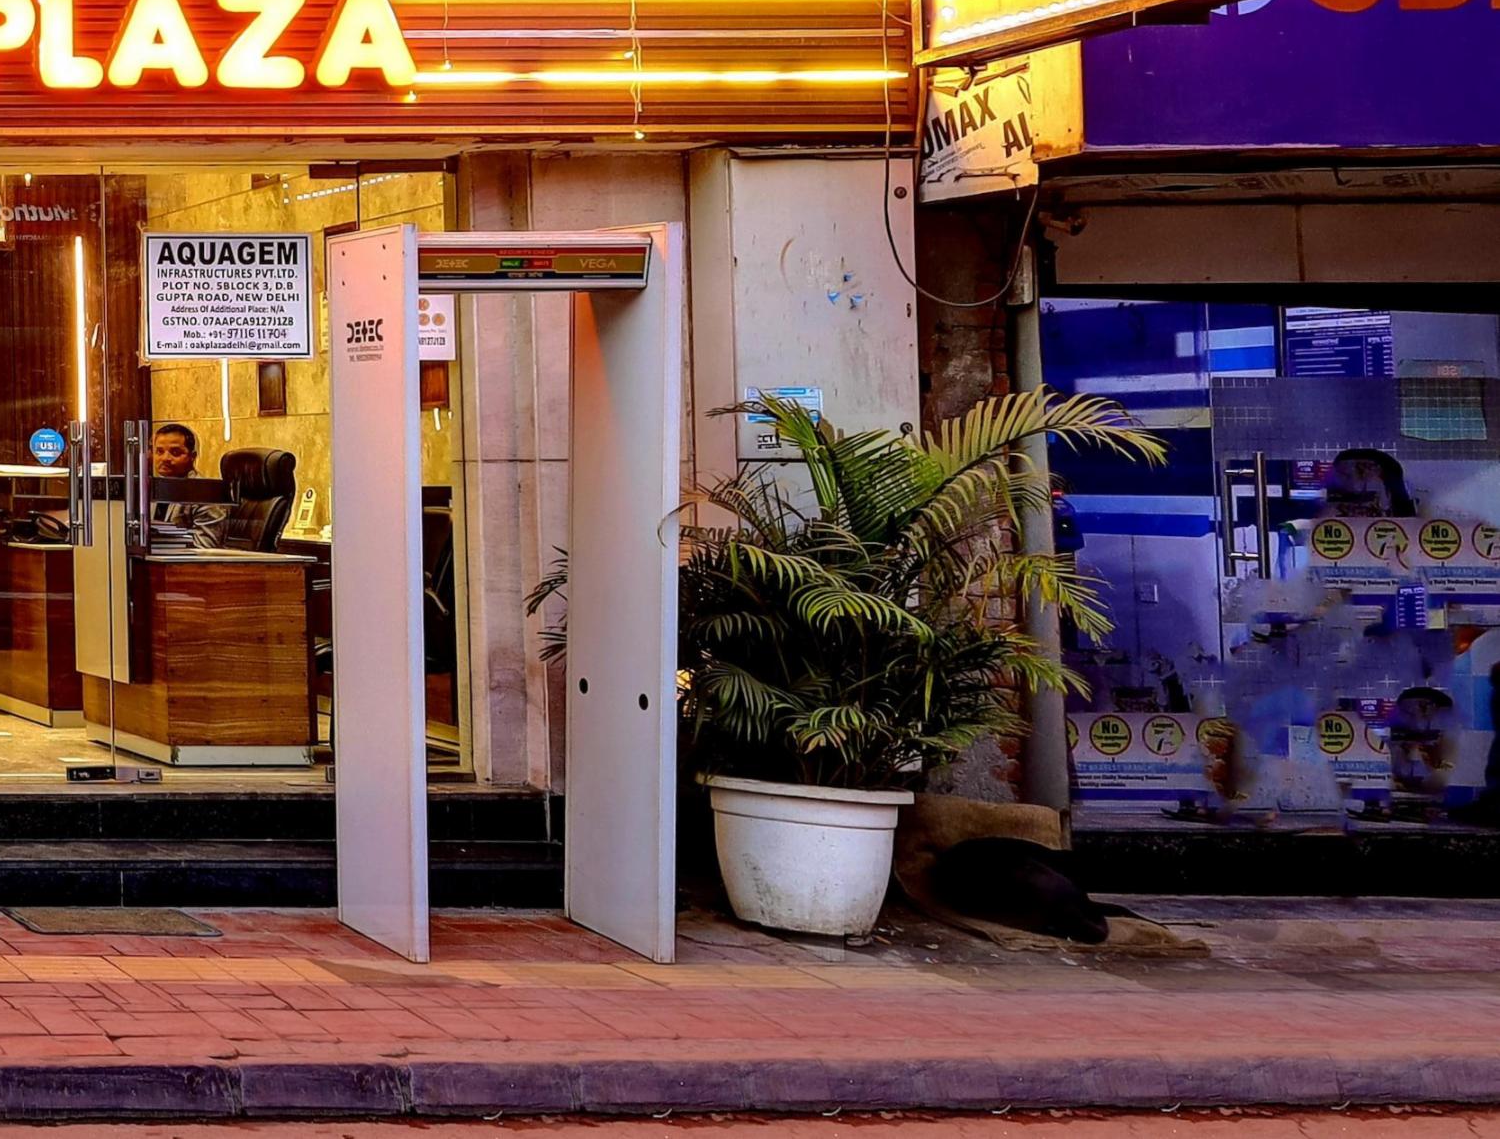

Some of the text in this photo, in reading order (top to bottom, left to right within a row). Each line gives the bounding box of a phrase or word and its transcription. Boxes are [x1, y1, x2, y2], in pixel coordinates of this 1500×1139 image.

[157, 241, 298, 267] AQUAGEM
[579, 258, 617, 269] VEGA
[157, 268, 298, 278] INFRASTRUCTURES PVT.LTD.
[162, 281, 294, 292] PLOT NO. 5BLOCK 3, D.B
[156, 293, 300, 303] GUPTA ROAD, NEW DELHI
[170, 305, 199, 313] Address
[200, 305, 208, 313] Of
[209, 305, 246, 313] Additional
[270, 305, 285, 314] N/A
[162, 317, 201, 326] GSTNO.
[156, 341, 183, 349] E-mail
[189, 341, 301, 350] oakplazadelhi@gmail.com
[1323, 525, 1342, 538] No
[1431, 525, 1449, 538] No
